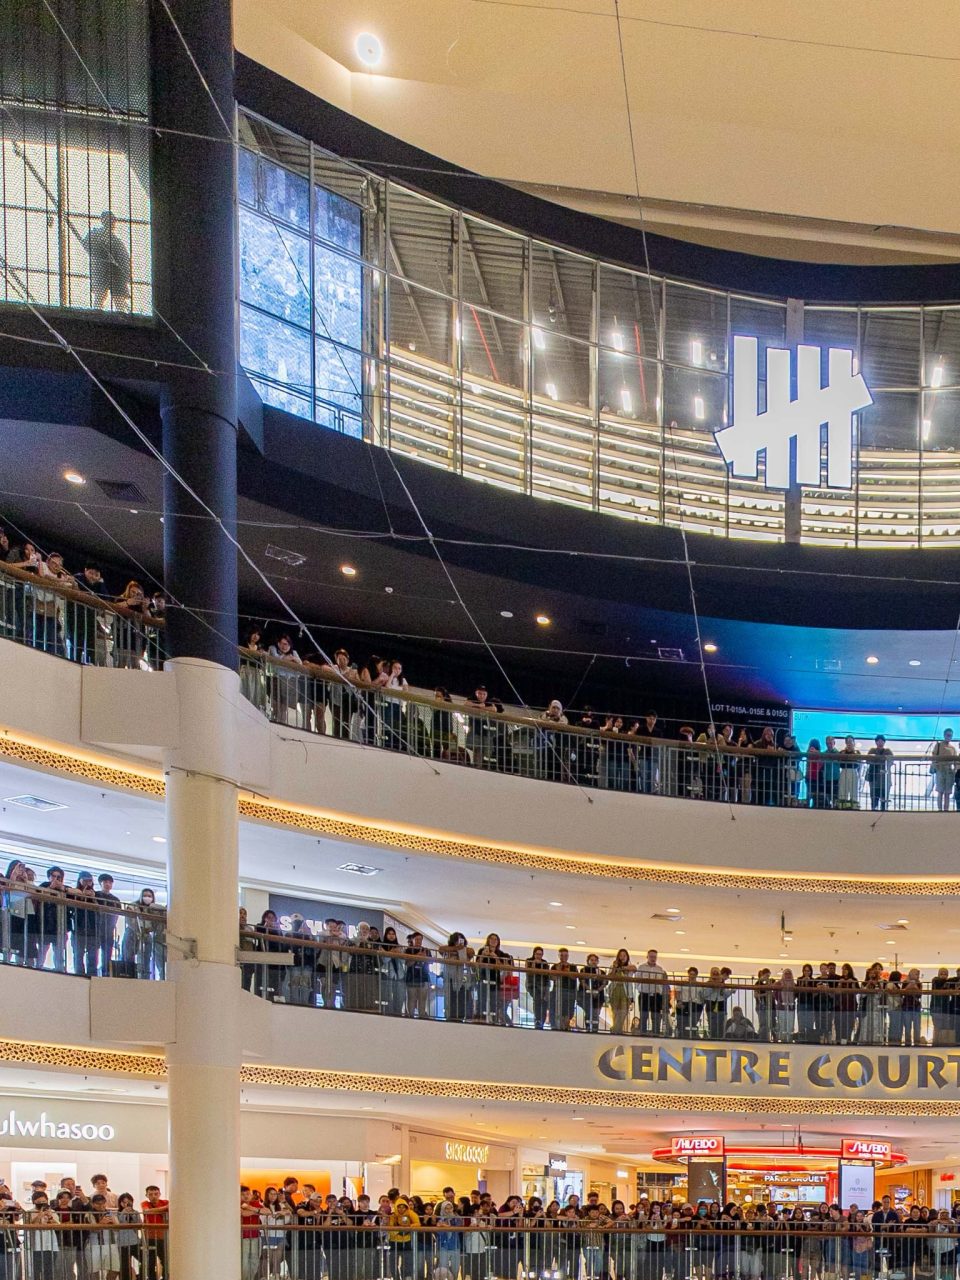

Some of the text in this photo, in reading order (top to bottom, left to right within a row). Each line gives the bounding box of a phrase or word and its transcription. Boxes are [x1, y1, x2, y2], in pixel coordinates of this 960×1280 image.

[712, 704, 725, 712] LOT
[597, 1044, 790, 1086] CENTRE
[675, 1139, 717, 1150] SHISEIDO
[849, 1142, 889, 1152] SHISEIDO
